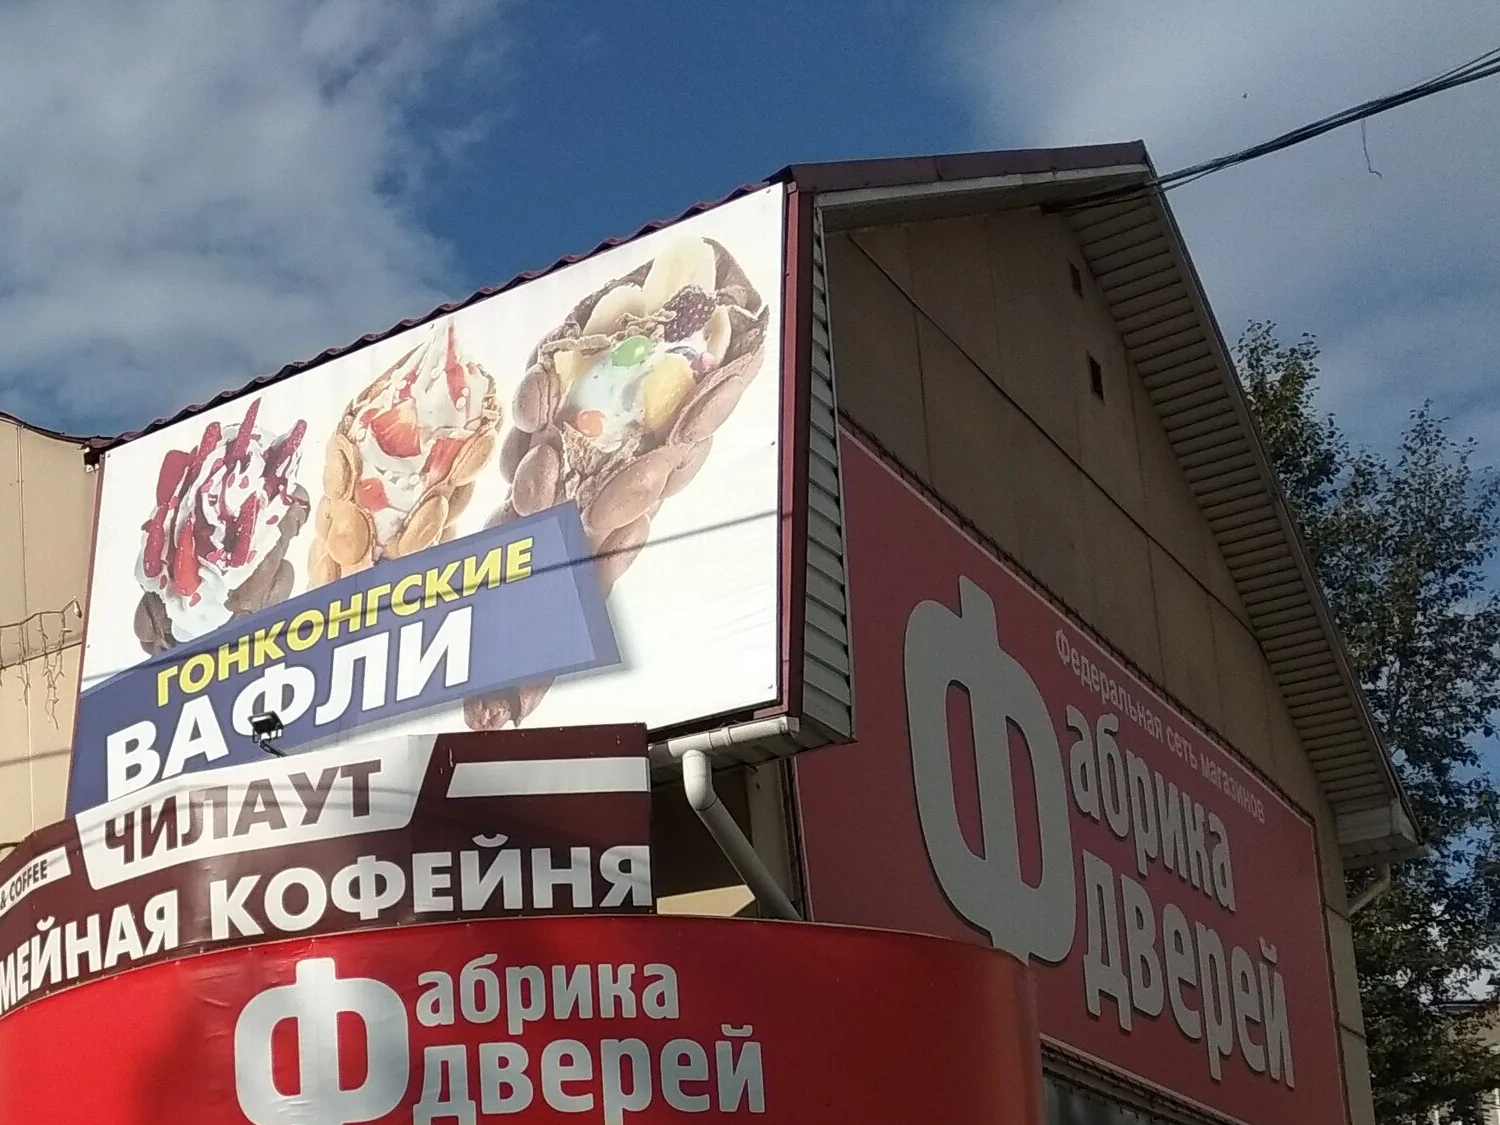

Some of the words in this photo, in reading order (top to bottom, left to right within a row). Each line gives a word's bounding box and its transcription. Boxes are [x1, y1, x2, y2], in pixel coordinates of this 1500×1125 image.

[106, 607, 475, 804] ВАФЛИ
[155, 536, 534, 707] ГОНКОНГСКИЕ
[103, 758, 383, 866] ЧИЛАУТ
[904, 575, 1236, 966] Фабрика
[1056, 629, 1164, 744] Федеральная
[1166, 727, 1199, 770] сеть
[1201, 753, 1265, 825] магазинов
[0, 890, 8, 910] &
[9, 859, 48, 902] COFFEE
[209, 832, 654, 941] КОФЕЙНЯ
[1083, 849, 1295, 1088] дверей
